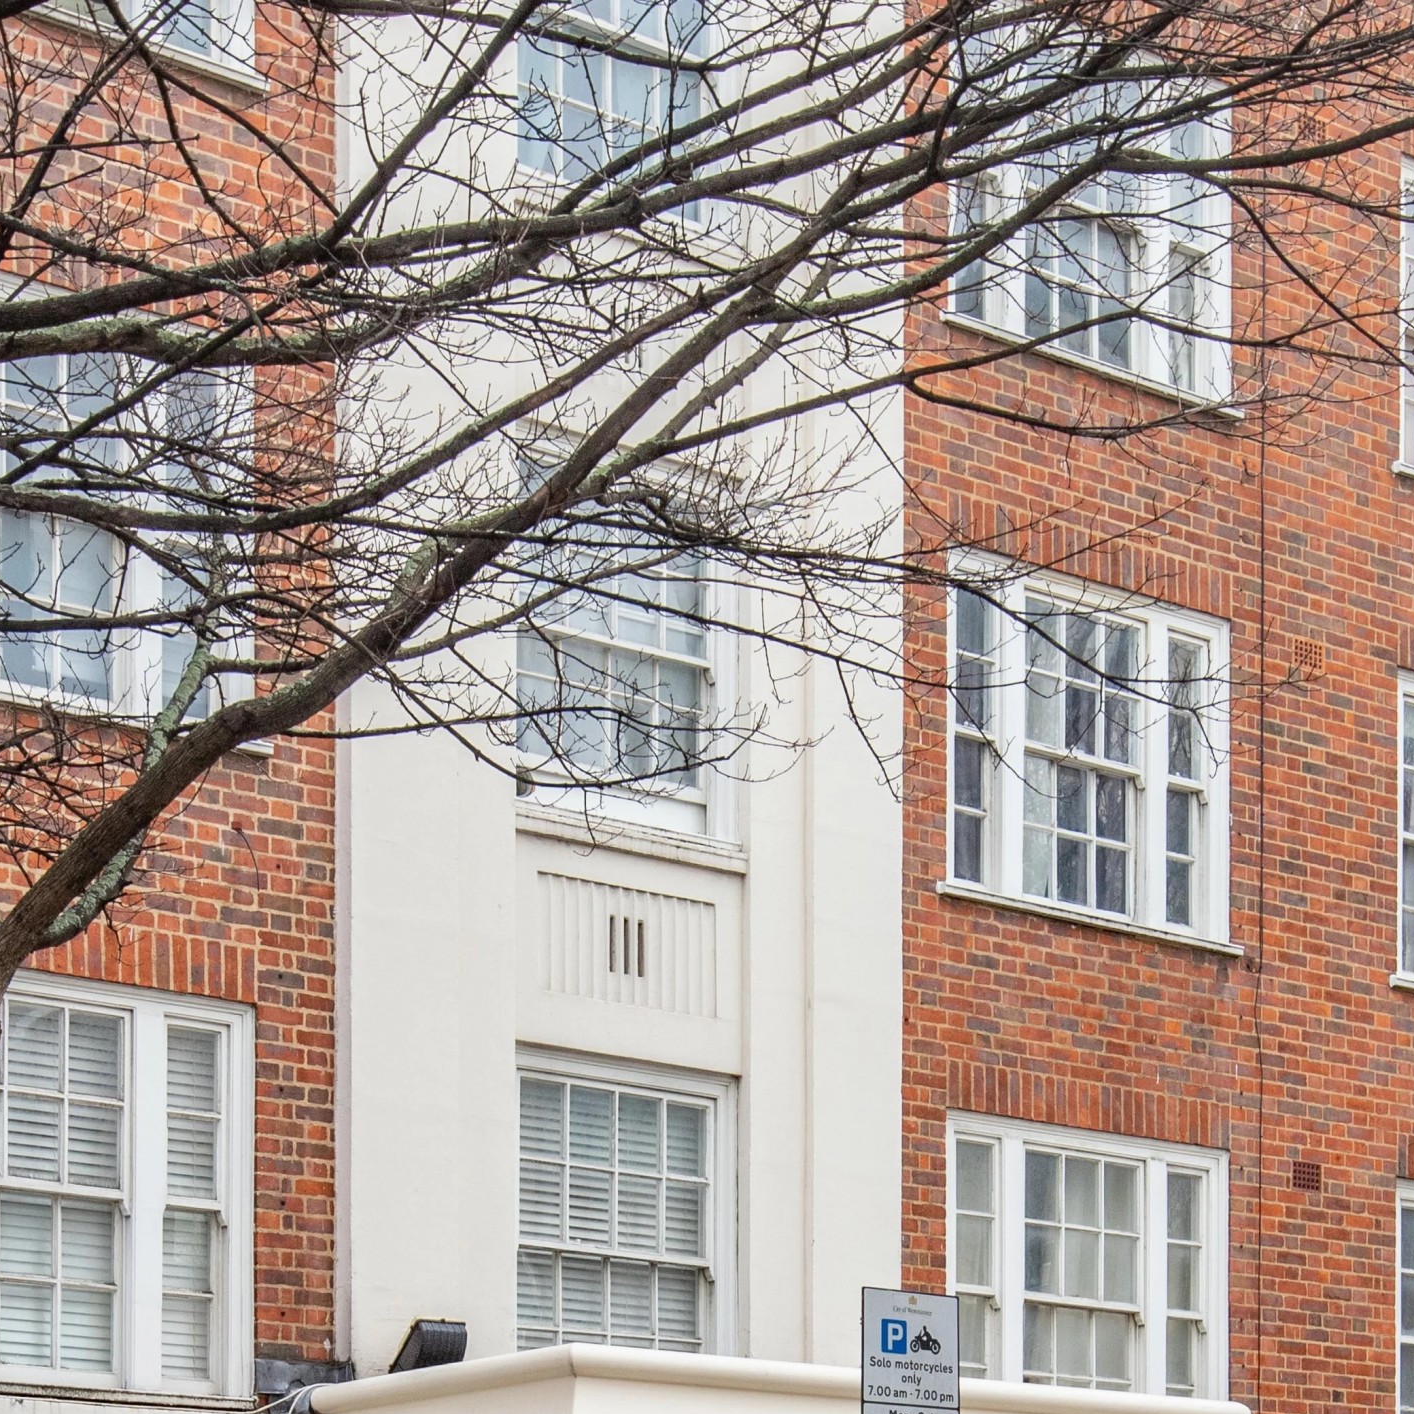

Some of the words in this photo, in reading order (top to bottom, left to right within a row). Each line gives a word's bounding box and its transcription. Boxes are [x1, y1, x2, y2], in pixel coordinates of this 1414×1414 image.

[887, 1322, 904, 1351] P
[869, 1356, 892, 1369] Solo
[895, 1360, 954, 1375] motorcycles
[901, 1372, 922, 1387] only
[867, 1385, 892, 1398] 7.00
[893, 1390, 908, 1399] am
[914, 1388, 938, 1402] 7.00
[939, 1394, 954, 1403] pm
